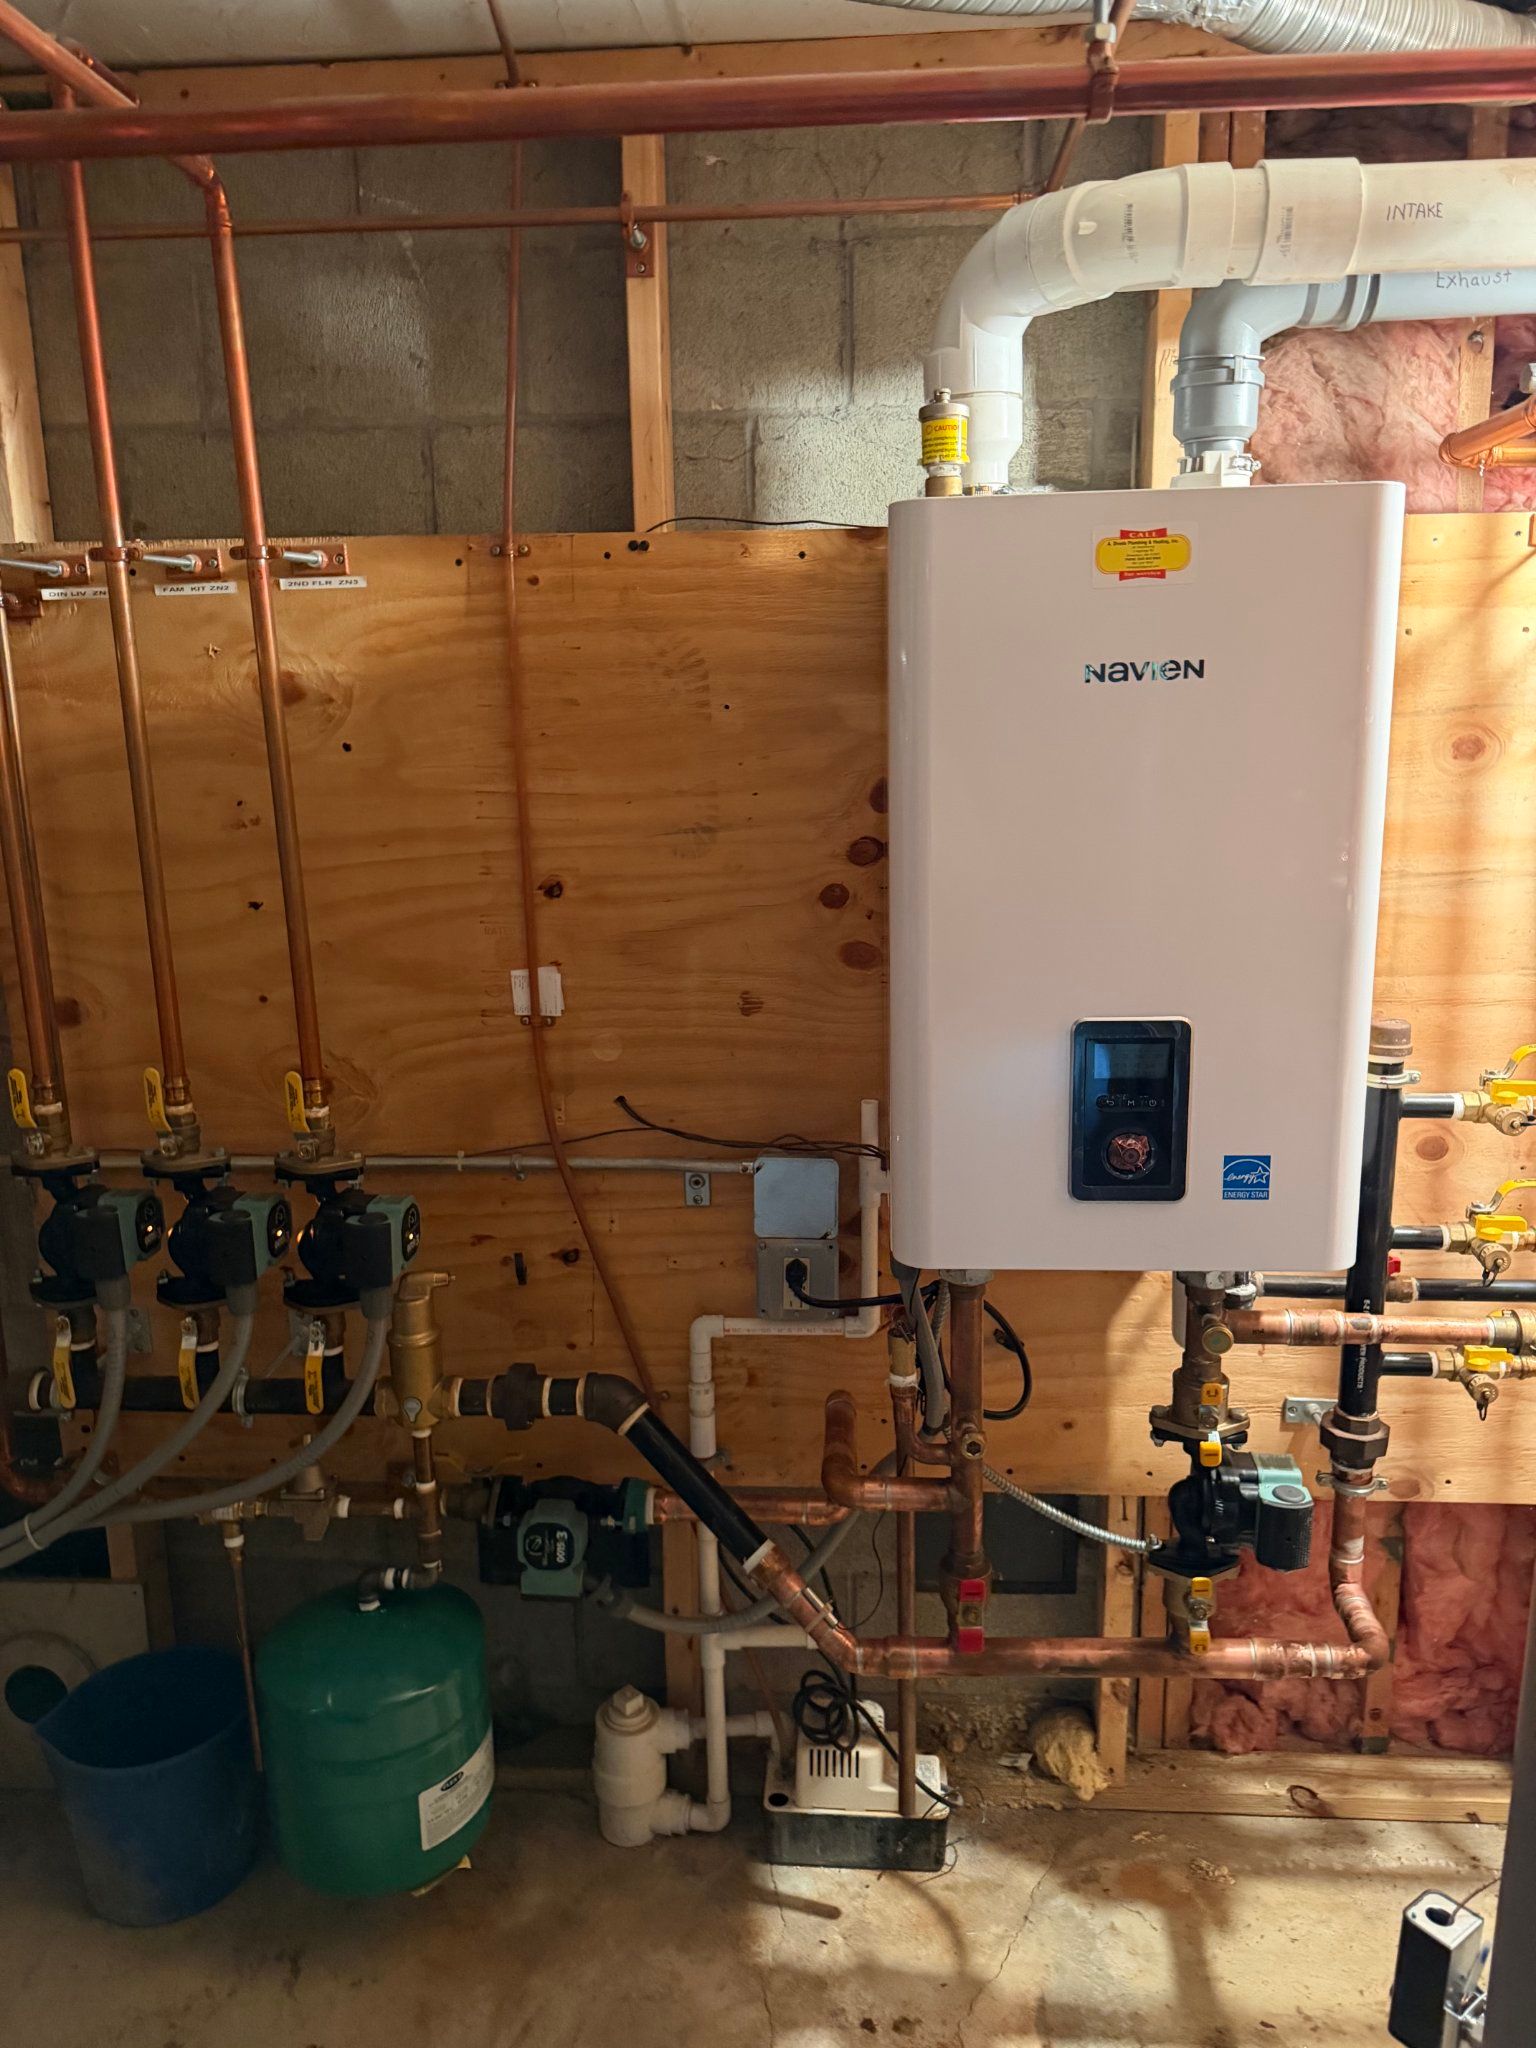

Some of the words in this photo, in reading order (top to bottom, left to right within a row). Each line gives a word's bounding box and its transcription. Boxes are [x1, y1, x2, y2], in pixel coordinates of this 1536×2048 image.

[1386, 202, 1444, 221] INTAKE
[1435, 269, 1513, 289] Exhaust
[934, 424, 961, 432] CAUTIO
